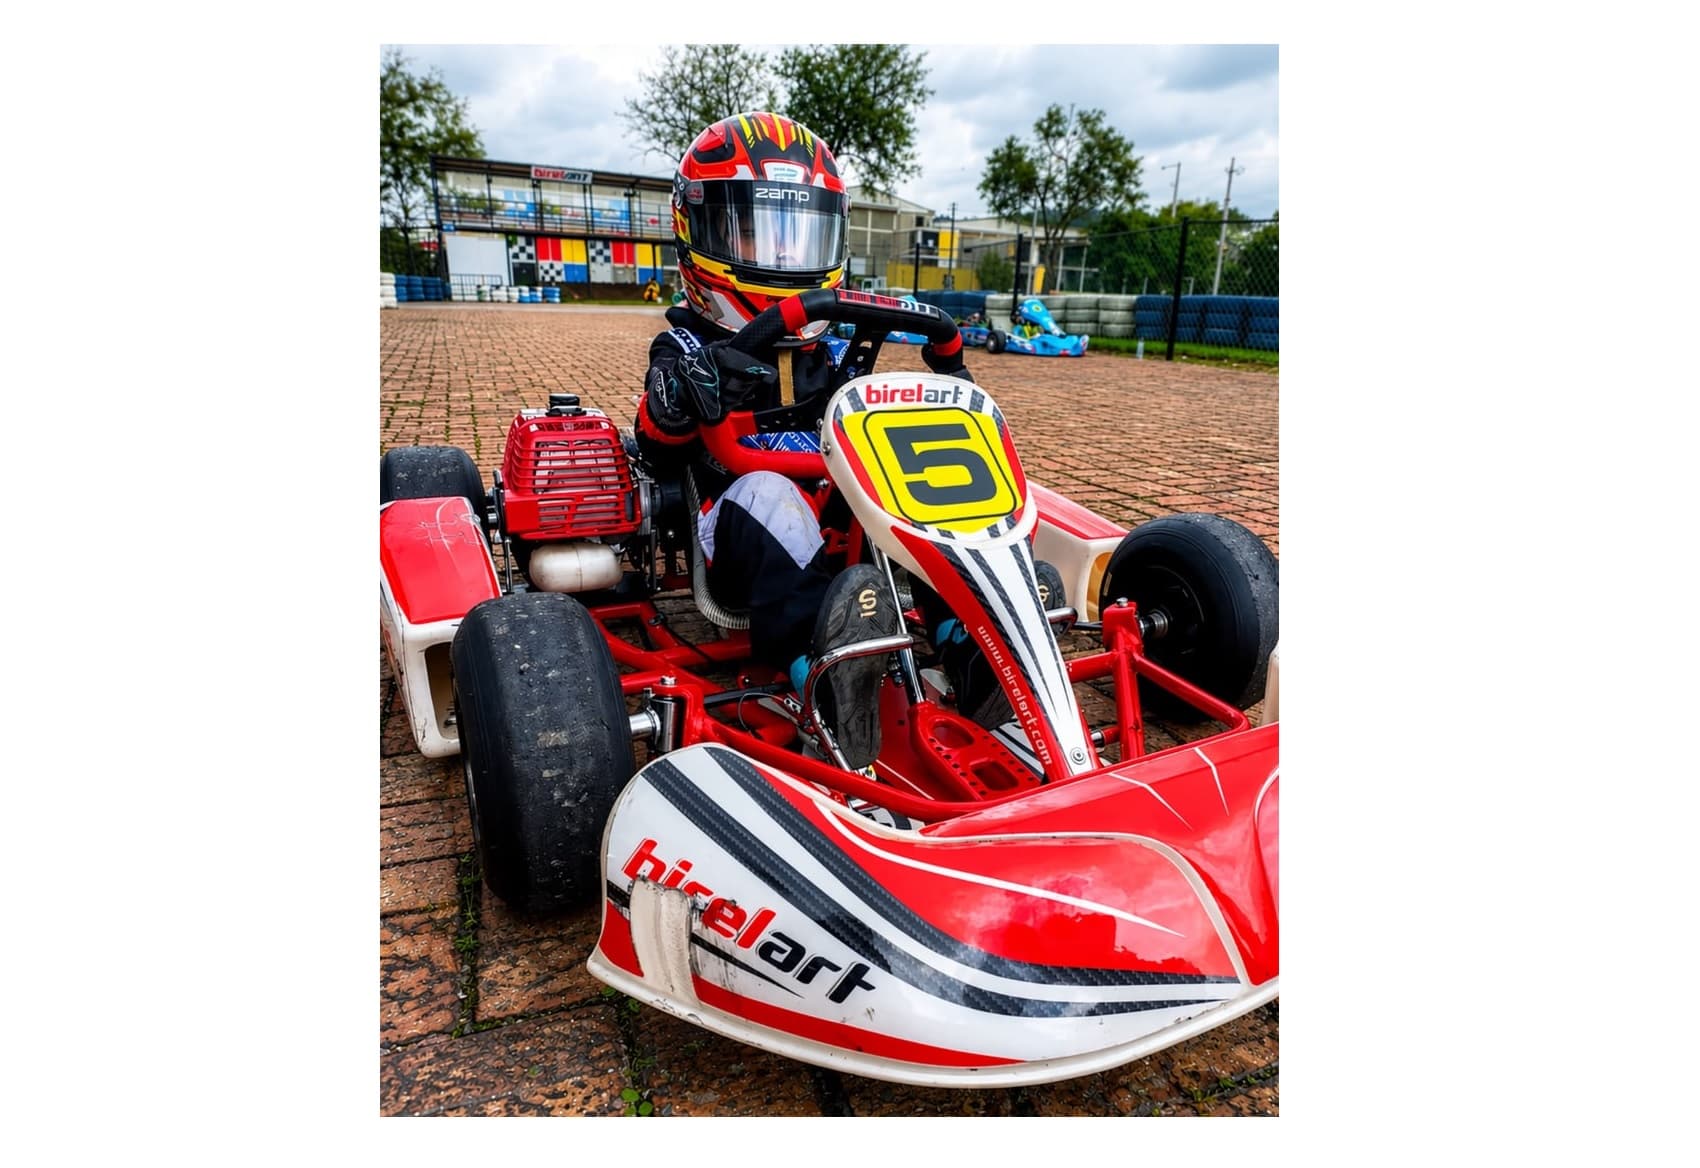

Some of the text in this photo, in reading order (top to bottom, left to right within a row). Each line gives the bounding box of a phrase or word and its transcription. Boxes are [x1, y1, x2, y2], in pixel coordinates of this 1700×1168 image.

[755, 187, 810, 203] zamp
[865, 384, 963, 404] birelart
[883, 423, 998, 506] 5
[977, 626, 1053, 765] www.birelart.com
